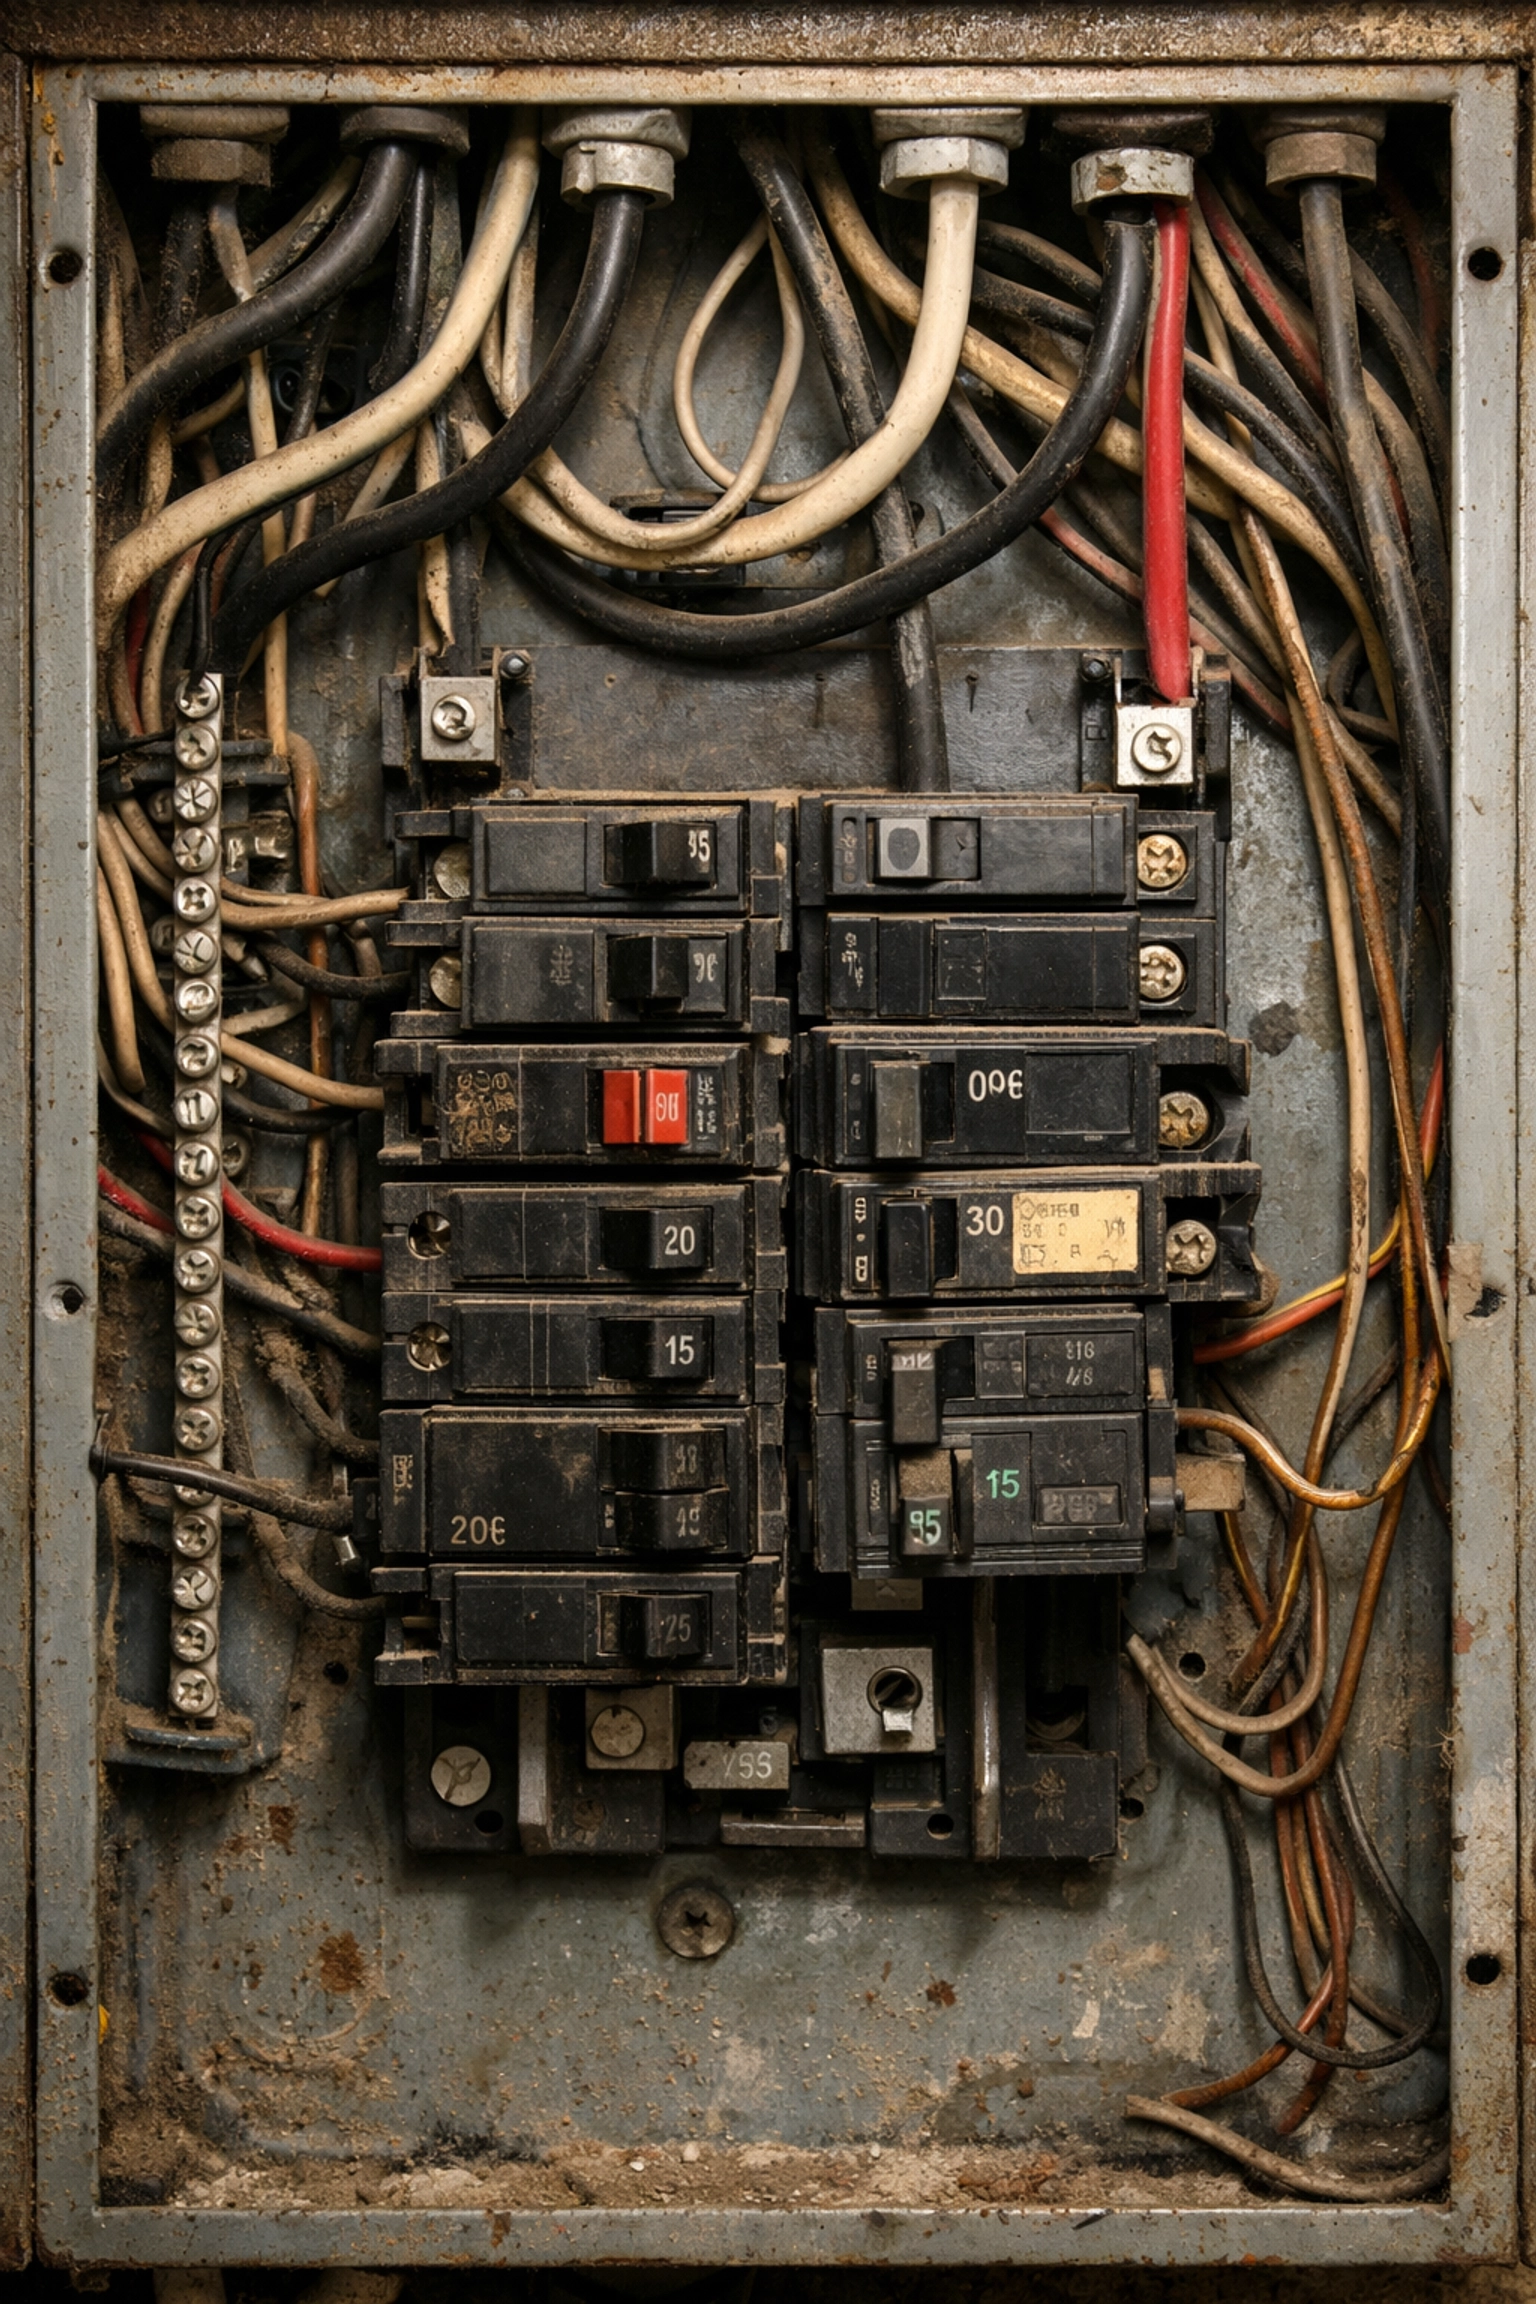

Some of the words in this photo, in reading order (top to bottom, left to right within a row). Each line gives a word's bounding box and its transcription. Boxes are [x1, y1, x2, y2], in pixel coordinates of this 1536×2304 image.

[966, 1205, 1004, 1236] 30
[664, 1225, 696, 1255] 20
[665, 1335, 694, 1365] 15
[986, 1469, 1020, 1499] 15
[665, 1613, 691, 1644] 25
